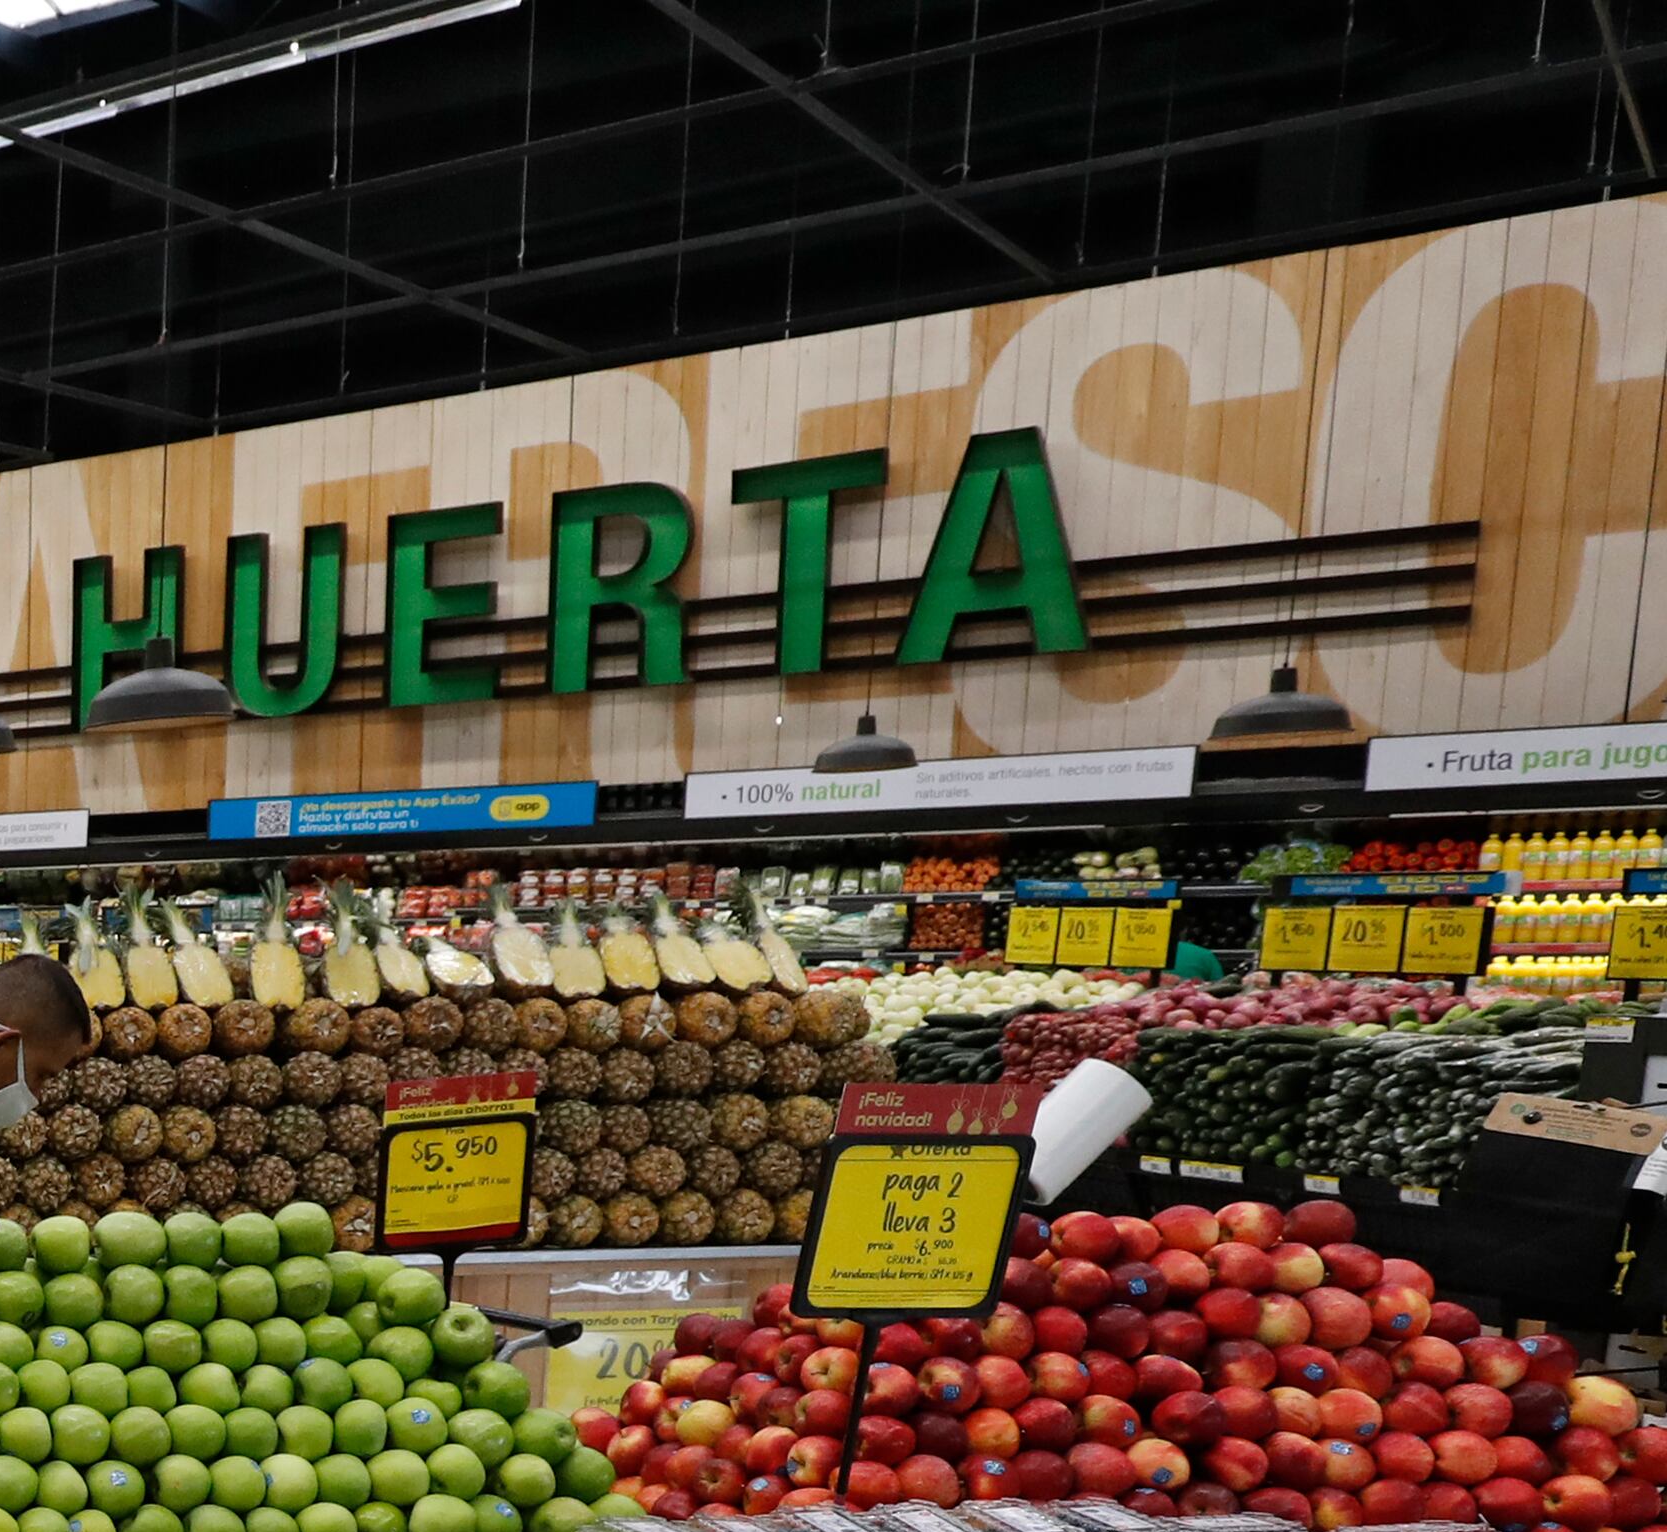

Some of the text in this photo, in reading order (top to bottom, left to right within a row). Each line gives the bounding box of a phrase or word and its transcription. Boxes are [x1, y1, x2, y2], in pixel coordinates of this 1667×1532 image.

[71, 425, 1091, 734] HUERTA
[1441, 741, 1667, 775] Fruta para jugo
[916, 771, 936, 784] Sin
[939, 770, 985, 784] aditivos
[1058, 763, 1104, 778] hechos
[1108, 763, 1133, 775] con
[1136, 759, 1174, 774] frutas
[736, 779, 881, 805] 100% natural
[915, 786, 972, 801] naturales.
[320, 798, 396, 812] descargaste
[398, 798, 411, 809] tu
[413, 795, 438, 810] App
[441, 793, 482, 808] Éxito?
[516, 801, 540, 815] app
[299, 812, 331, 824] Hazlo
[344, 809, 391, 822] disfruta
[394, 811, 410, 820] un
[298, 820, 347, 835] almacén
[351, 820, 375, 832] solo
[377, 820, 408, 833] para
[858, 1092, 906, 1110] ¡Feliz
[398, 1110, 427, 1121] Todos
[465, 1102, 515, 1114] ahorras
[855, 1111, 934, 1127] navidad!
[412, 1134, 498, 1173] $5.950
[882, 1172, 964, 1200] paga 2
[882, 1202, 957, 1233] lleva 3
[622, 1316, 648, 1326] con
